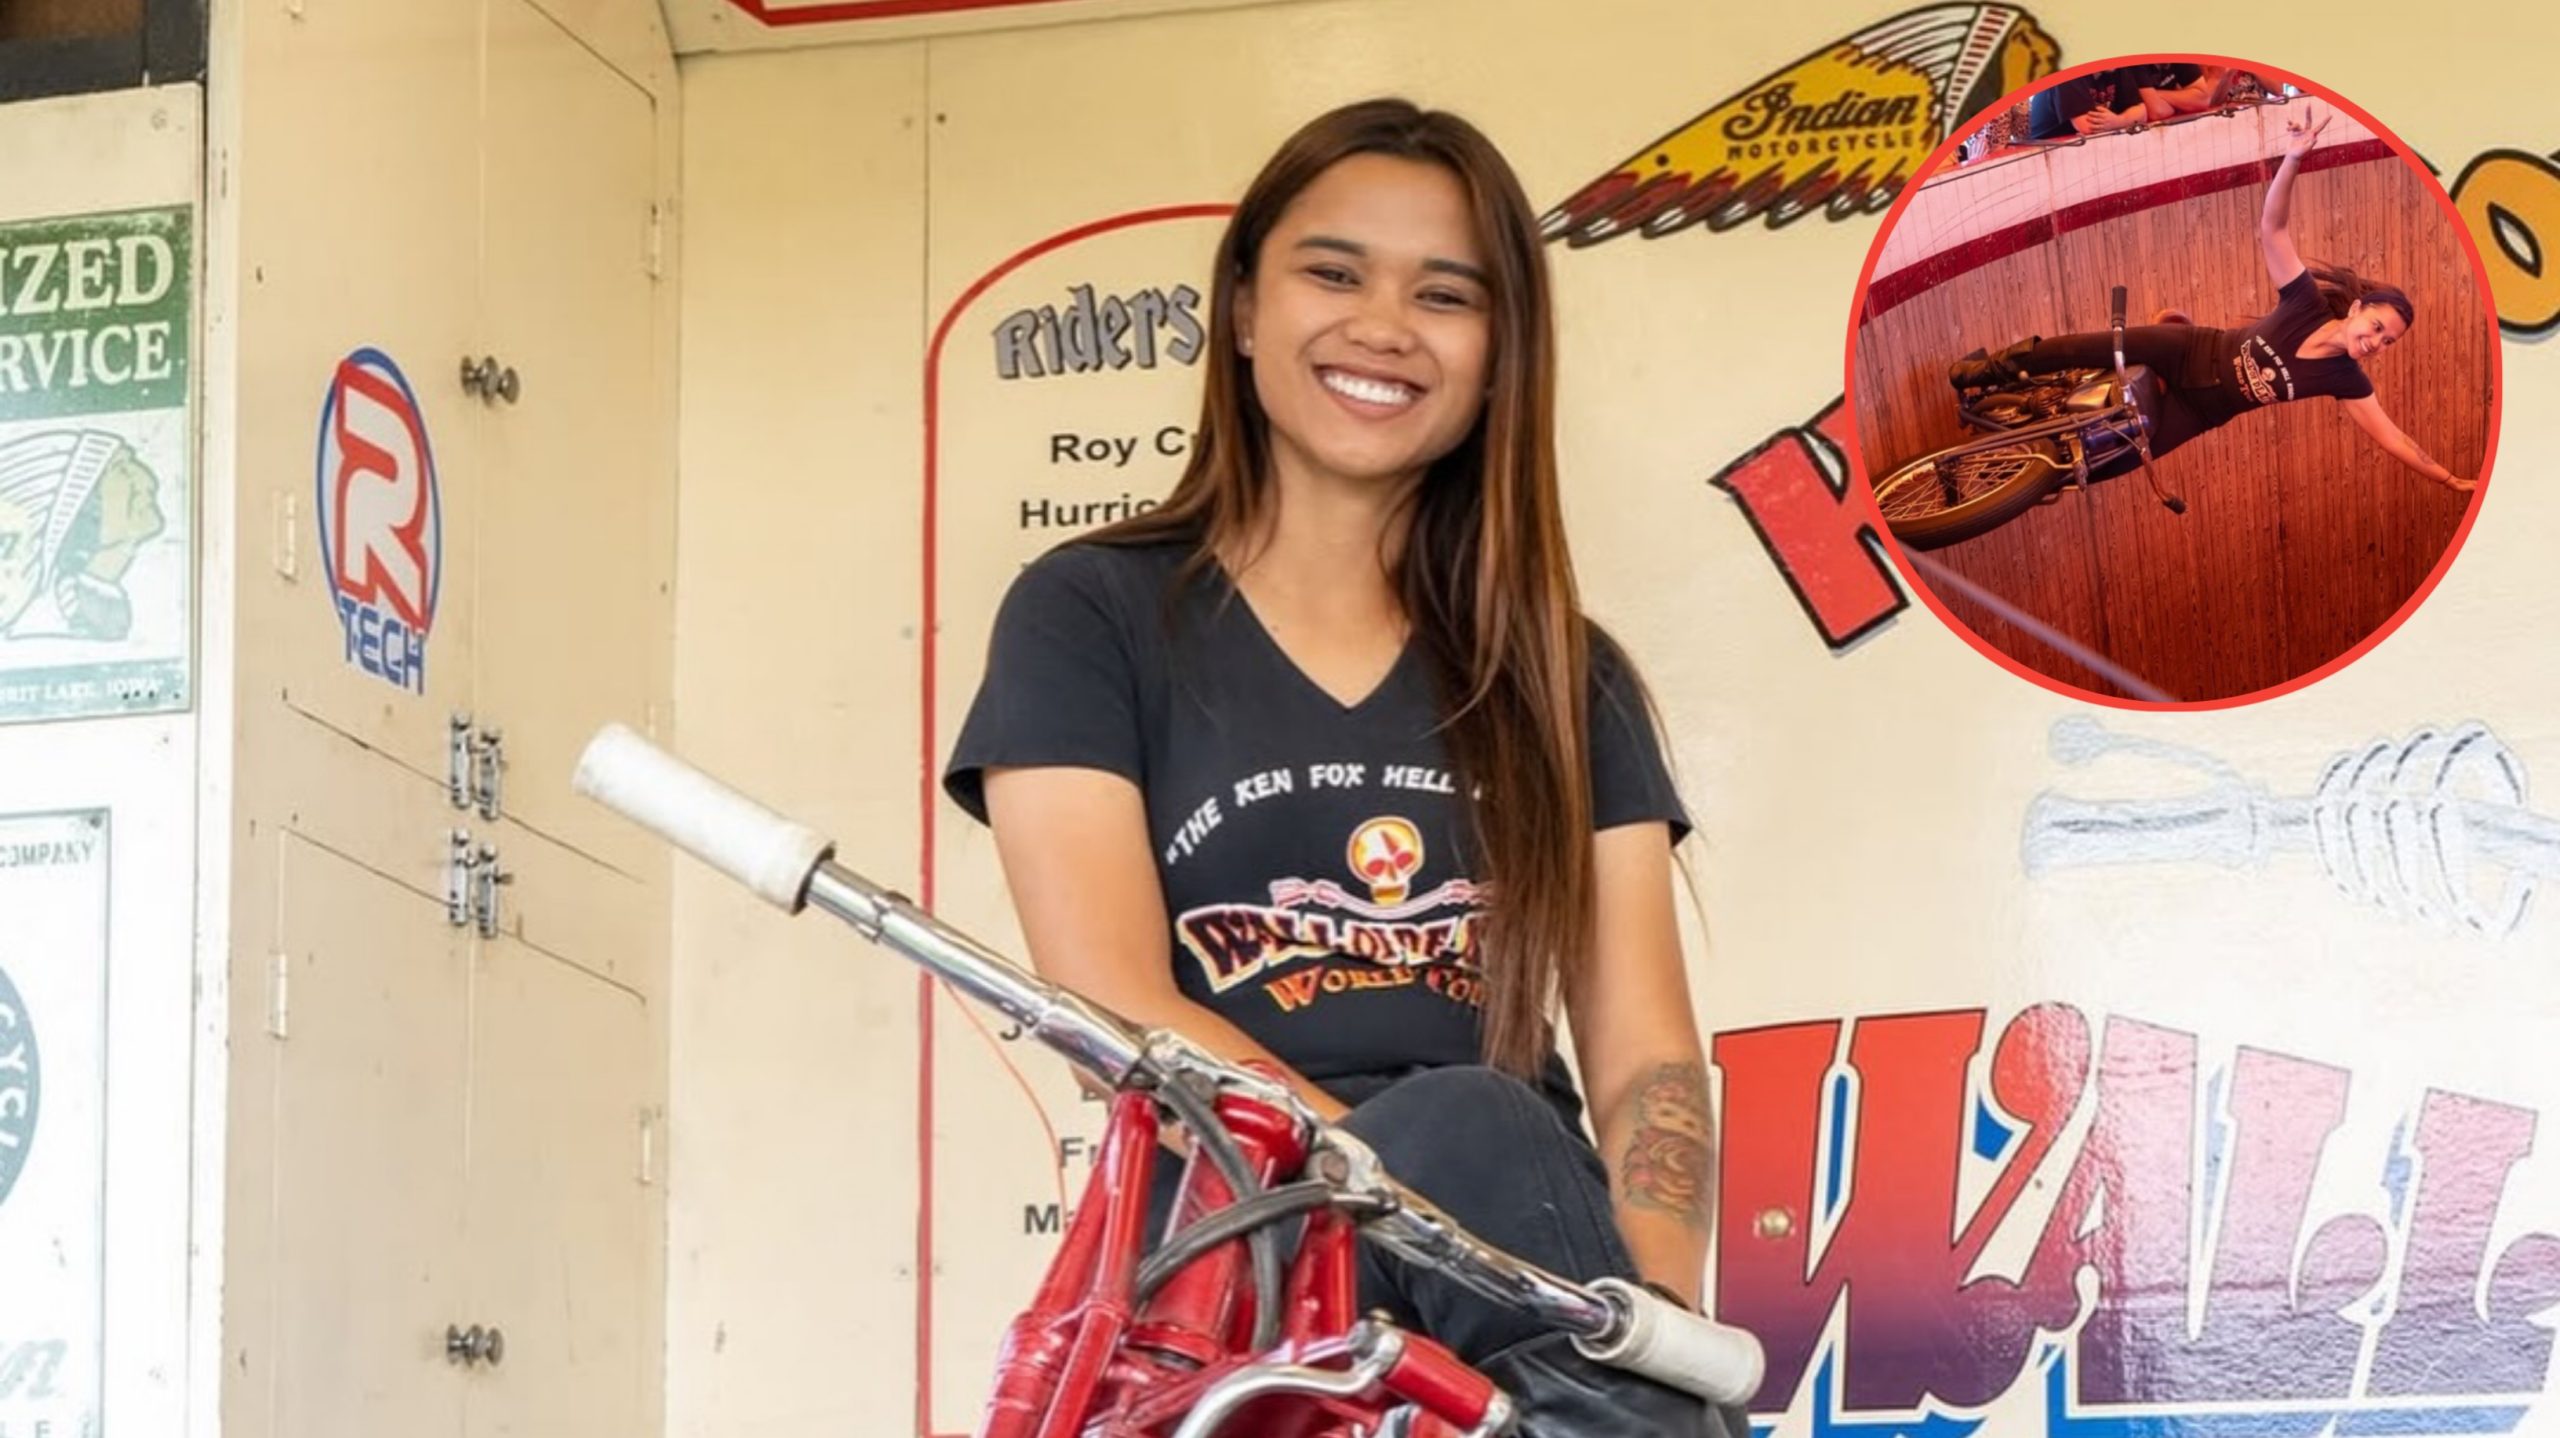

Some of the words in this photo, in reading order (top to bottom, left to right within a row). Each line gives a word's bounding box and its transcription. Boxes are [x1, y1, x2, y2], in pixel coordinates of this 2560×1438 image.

[1722, 82, 1920, 141] Indian
[1727, 130, 1913, 161] MOTORCYCLE
[992, 283, 1206, 379] Riders
[1051, 433, 1138, 468] Roy
[1020, 493, 1159, 530] Hurric
[1234, 768, 1294, 807] KEN
[1308, 763, 1366, 789] FOX
[1382, 765, 1456, 795] HELL
